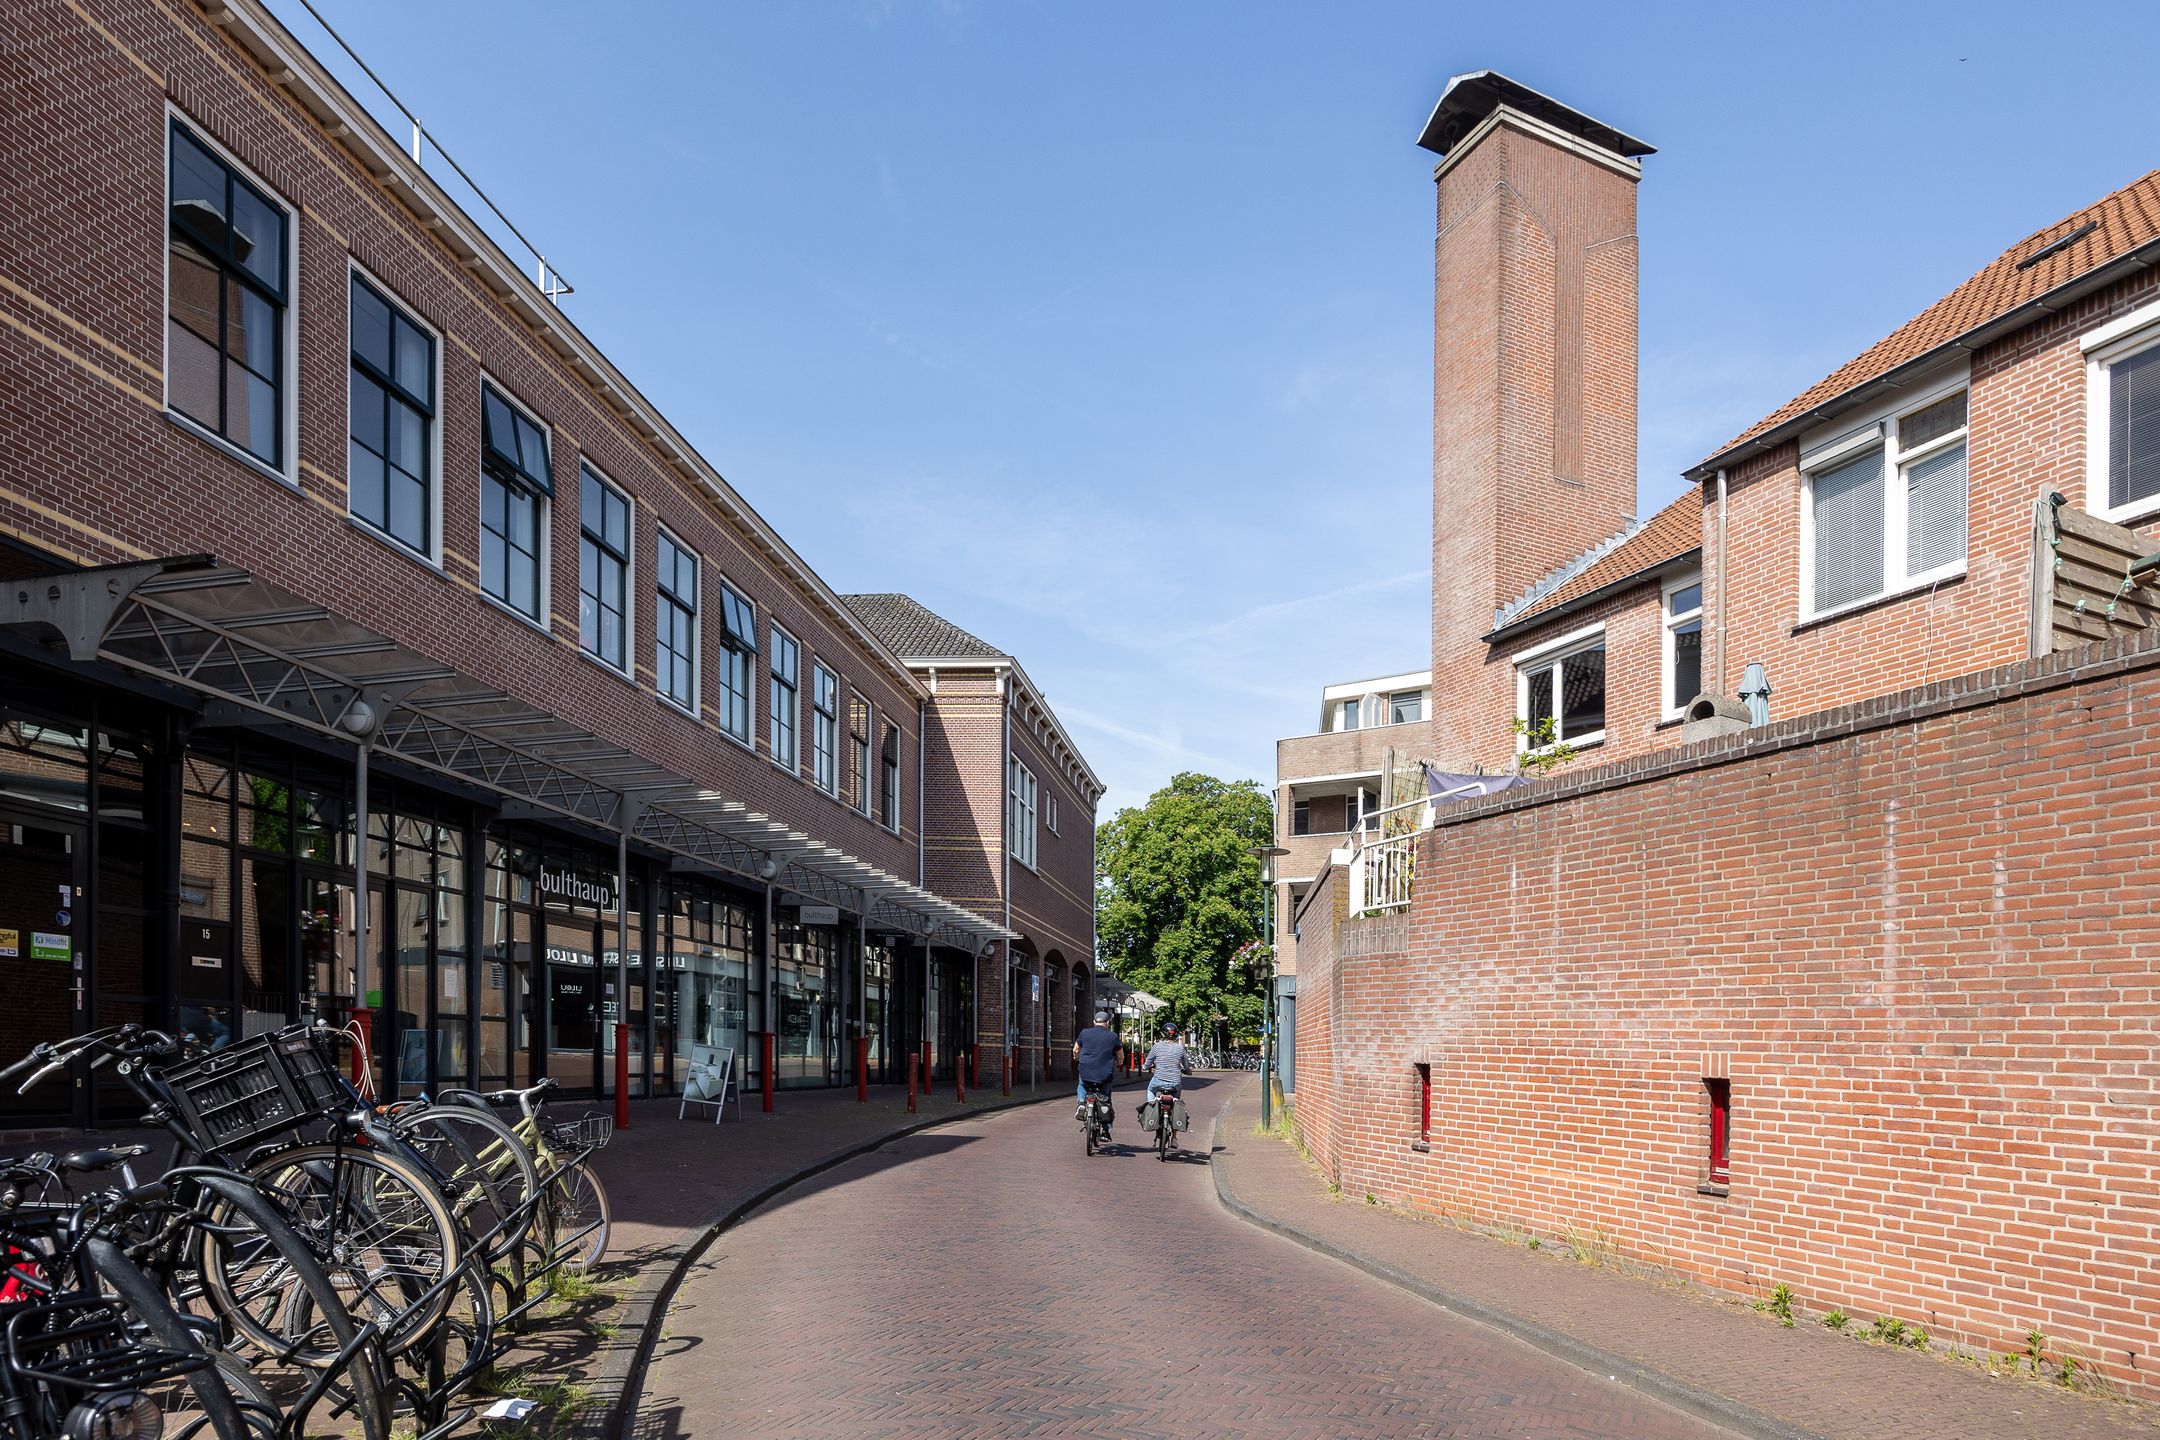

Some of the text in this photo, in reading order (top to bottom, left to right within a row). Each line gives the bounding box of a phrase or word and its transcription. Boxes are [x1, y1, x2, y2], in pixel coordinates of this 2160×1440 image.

[540, 864, 609, 910] bulthaup
[804, 911, 834, 920] bulthaup
[202, 928, 211, 940] 15
